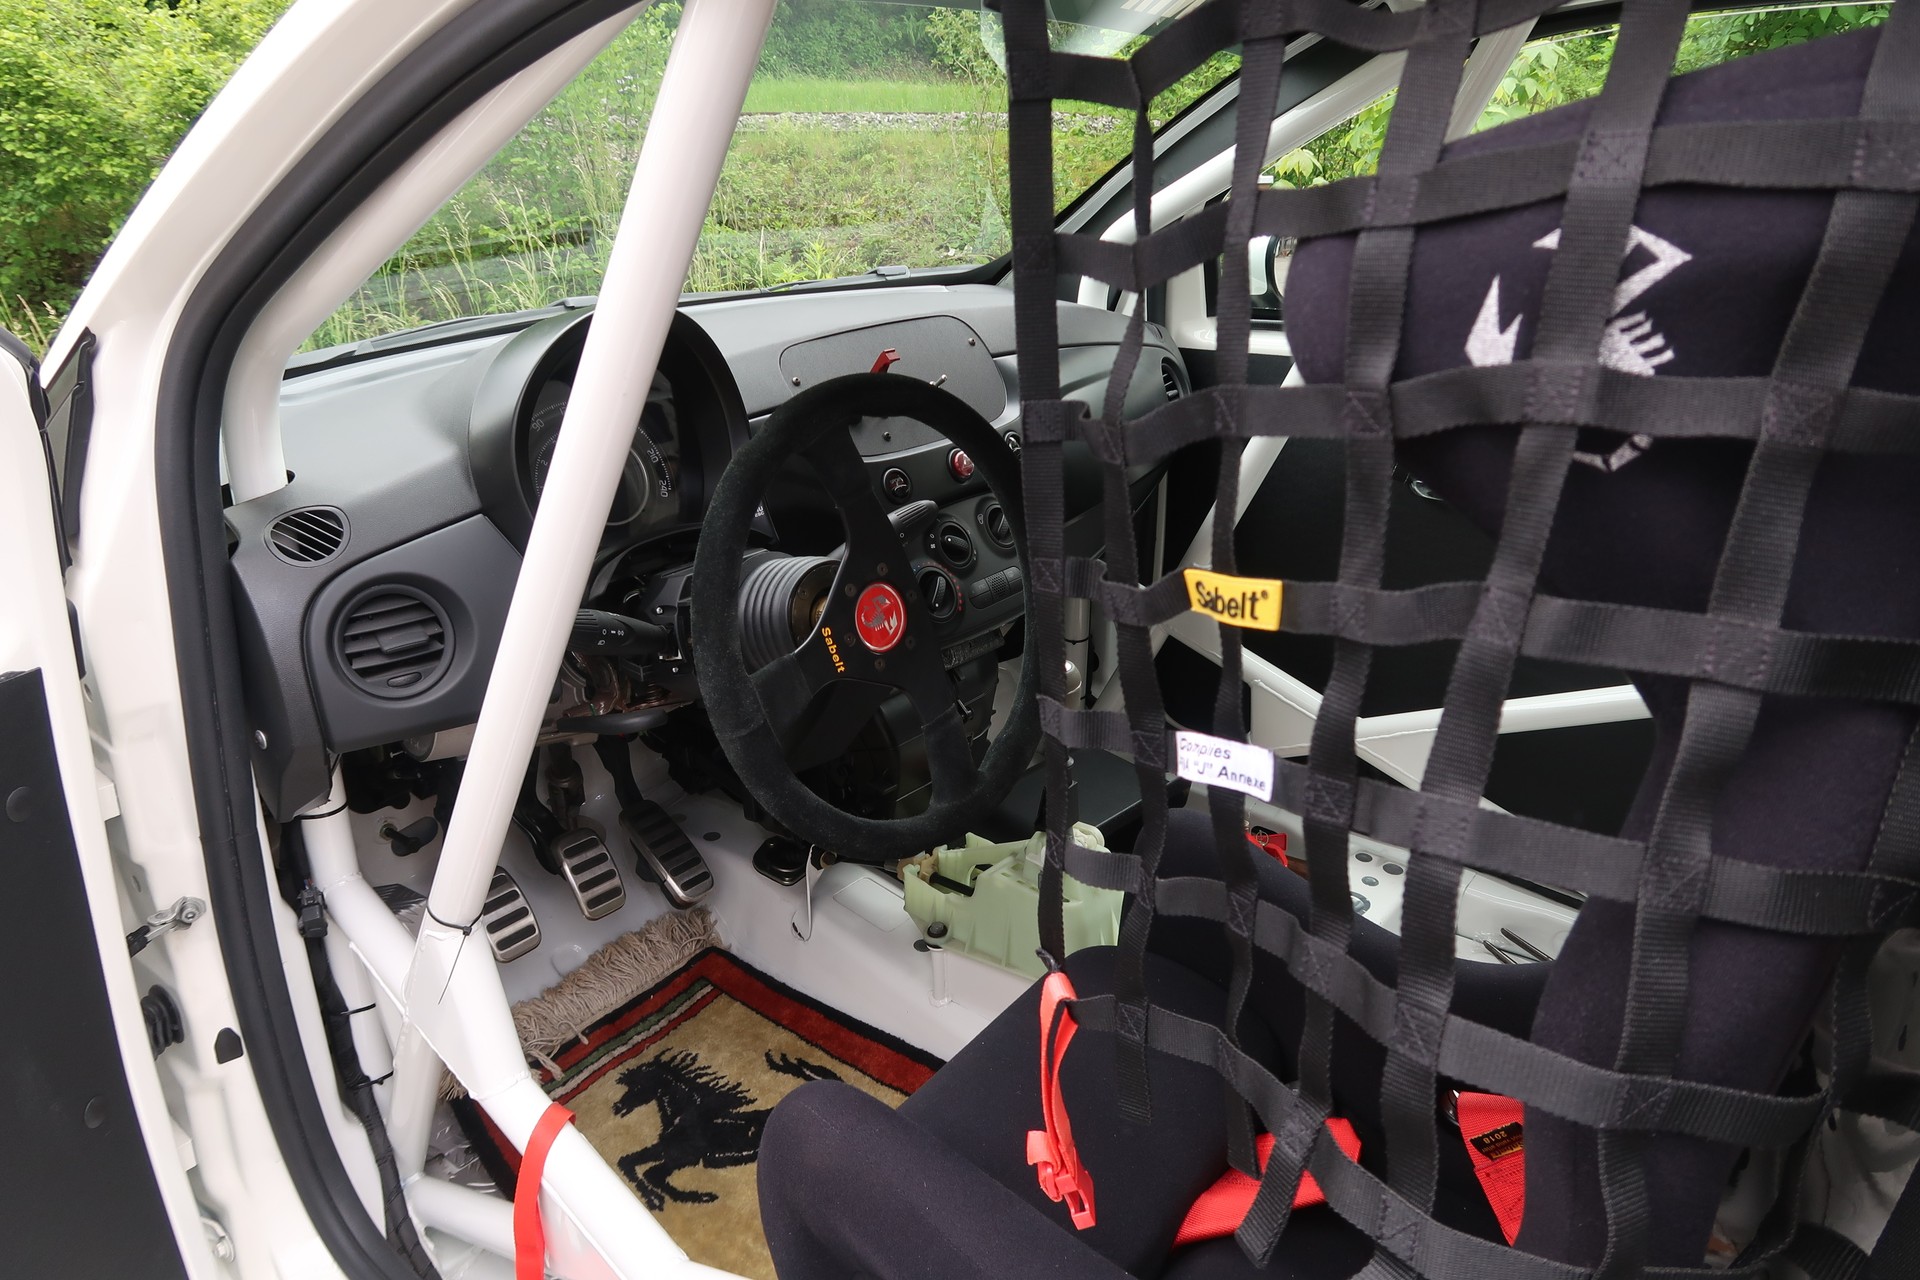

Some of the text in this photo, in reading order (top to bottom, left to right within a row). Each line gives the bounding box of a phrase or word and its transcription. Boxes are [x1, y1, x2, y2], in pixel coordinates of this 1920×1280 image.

[531, 418, 545, 432] 90
[646, 448, 659, 463] 210
[658, 479, 669, 498] 240
[821, 626, 846, 673] Sabelt
[1179, 737, 1232, 760] Complies
[1217, 765, 1266, 792] Annexe
